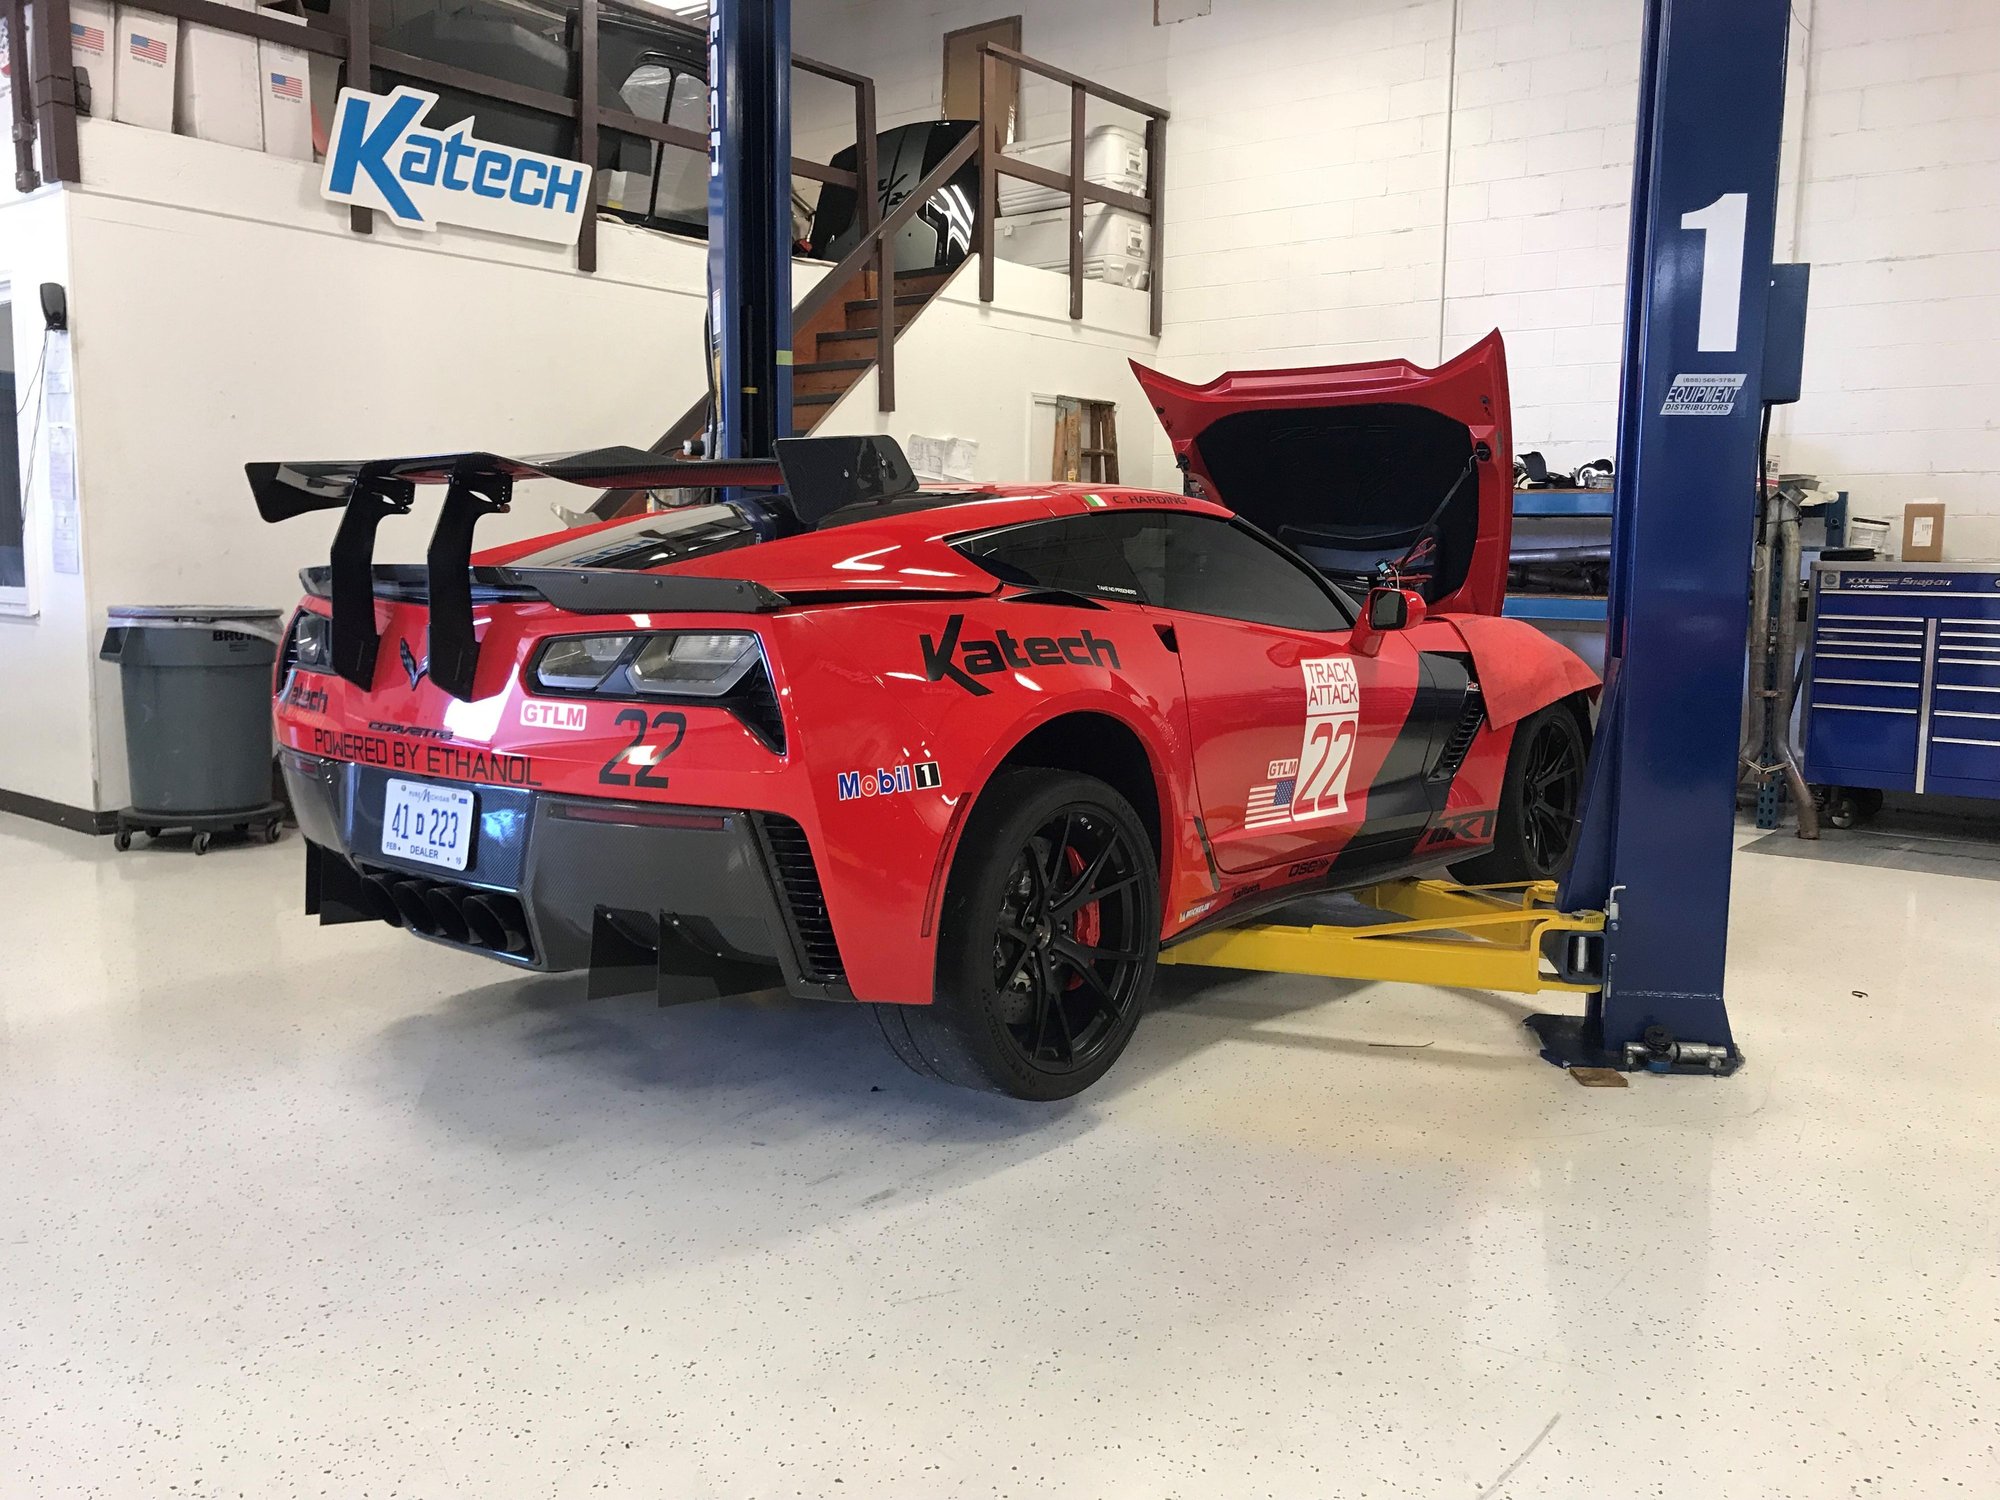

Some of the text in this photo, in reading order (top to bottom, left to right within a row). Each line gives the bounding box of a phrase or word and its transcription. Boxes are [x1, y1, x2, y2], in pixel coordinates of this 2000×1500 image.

[709, 0, 721, 177] tech
[1681, 193, 1748, 352] 1
[1665, 386, 1742, 403] EQUIPMENT
[1129, 495, 1188, 505] HARDING
[1900, 577, 1952, 588] Snap-on
[919, 614, 1121, 696] Katech
[1305, 662, 1353, 684] TRACK
[1308, 683, 1358, 706] ATTACK
[523, 704, 585, 727] GTLM
[314, 728, 543, 787] POWERED BY ETHANOL
[599, 708, 687, 789] 22
[838, 764, 912, 801] Mobil
[1269, 760, 1297, 776] GTLM
[1294, 720, 1356, 815] 22
[392, 803, 459, 849] 41 D 223
[410, 844, 439, 859] DEALER
